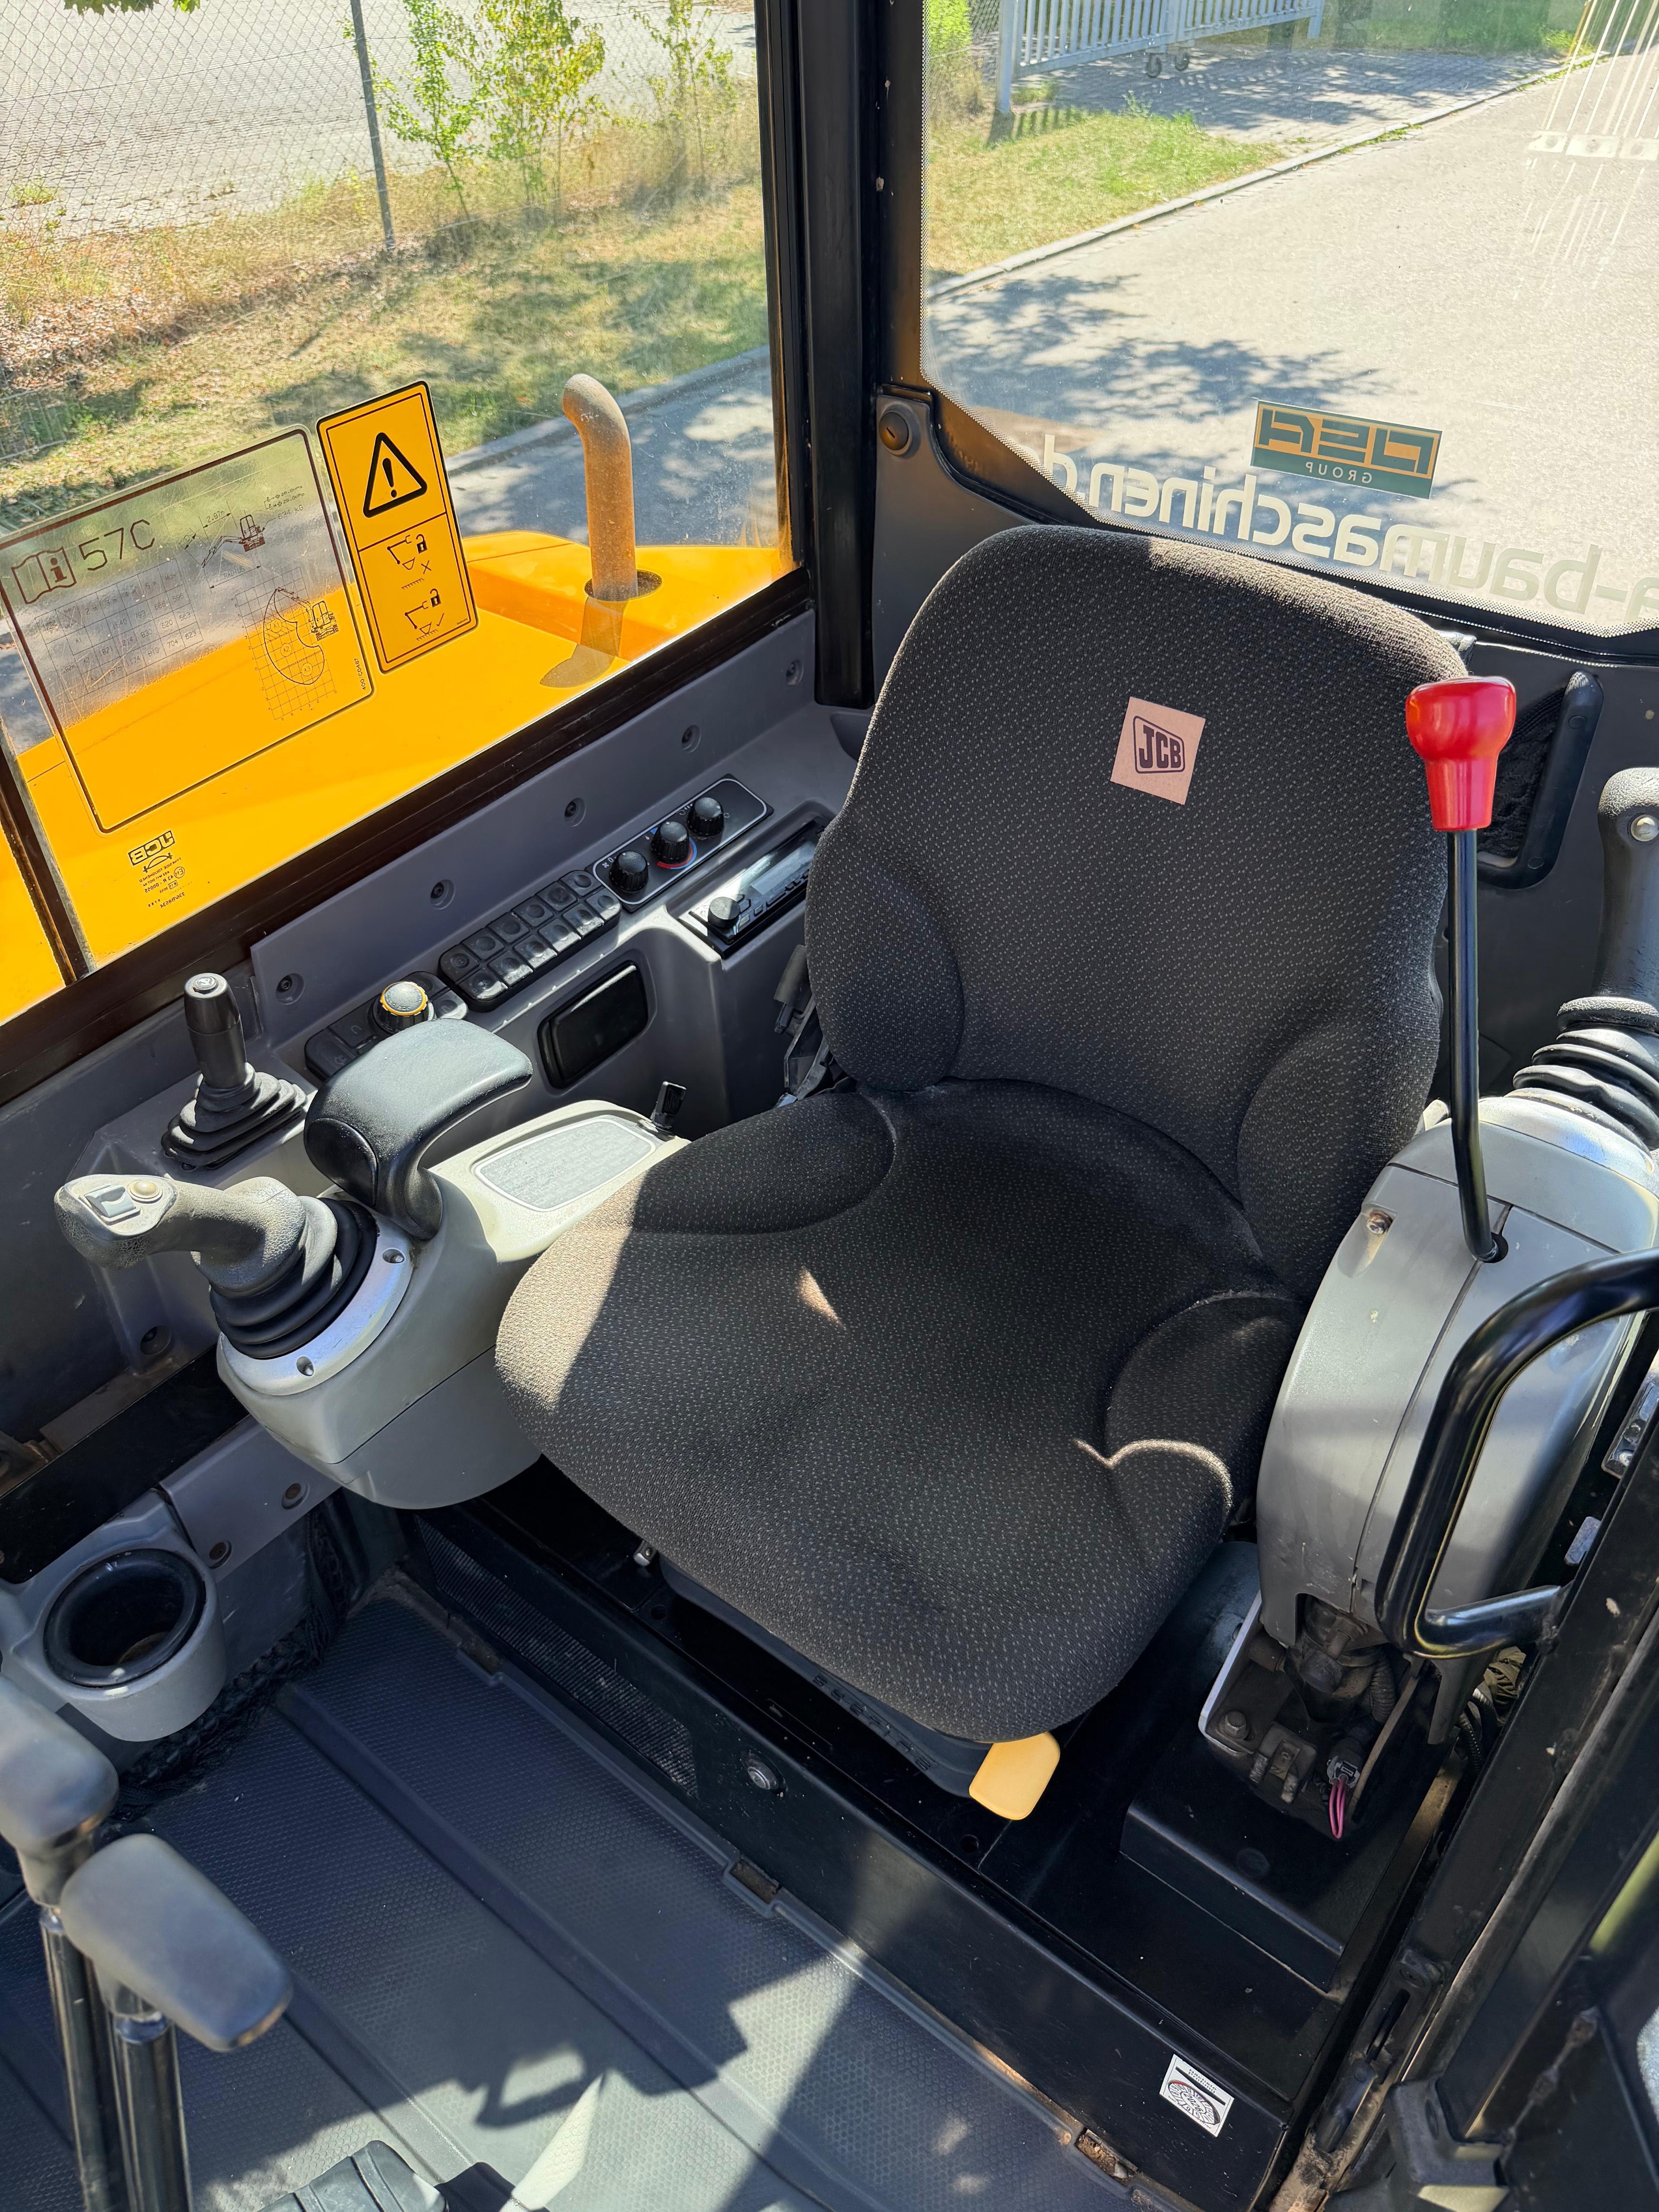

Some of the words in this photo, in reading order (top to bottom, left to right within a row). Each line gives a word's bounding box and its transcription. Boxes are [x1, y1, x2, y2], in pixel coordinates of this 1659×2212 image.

[79, 519, 155, 571] 57C
[223, 566, 245, 580] RADIUS
[167, 639, 178, 648] 704
[1139, 724, 1182, 769] JCB
[1183, 2093, 1204, 2112] 2026
